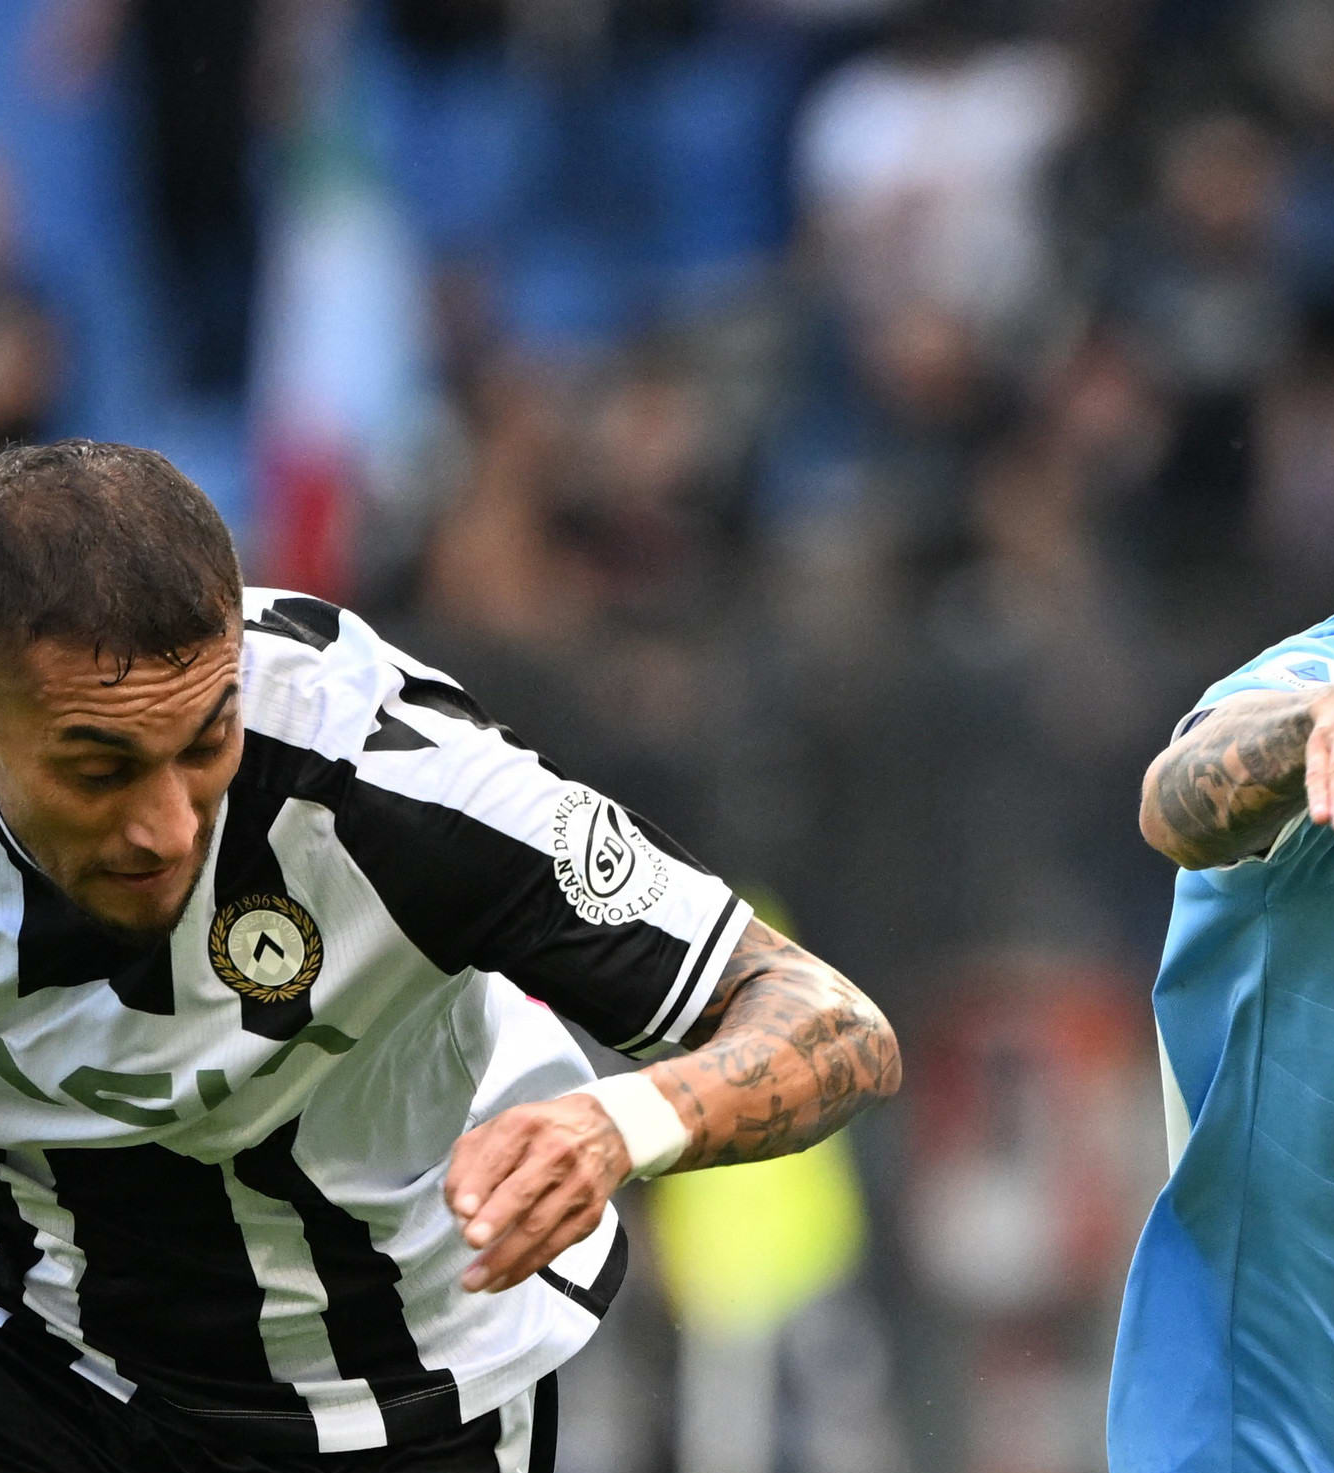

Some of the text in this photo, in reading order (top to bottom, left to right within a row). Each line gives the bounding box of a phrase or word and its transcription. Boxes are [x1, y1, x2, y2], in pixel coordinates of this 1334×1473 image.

[557, 858, 584, 902] SAN
[234, 893, 271, 913] 1896
[579, 899, 601, 920] DI
